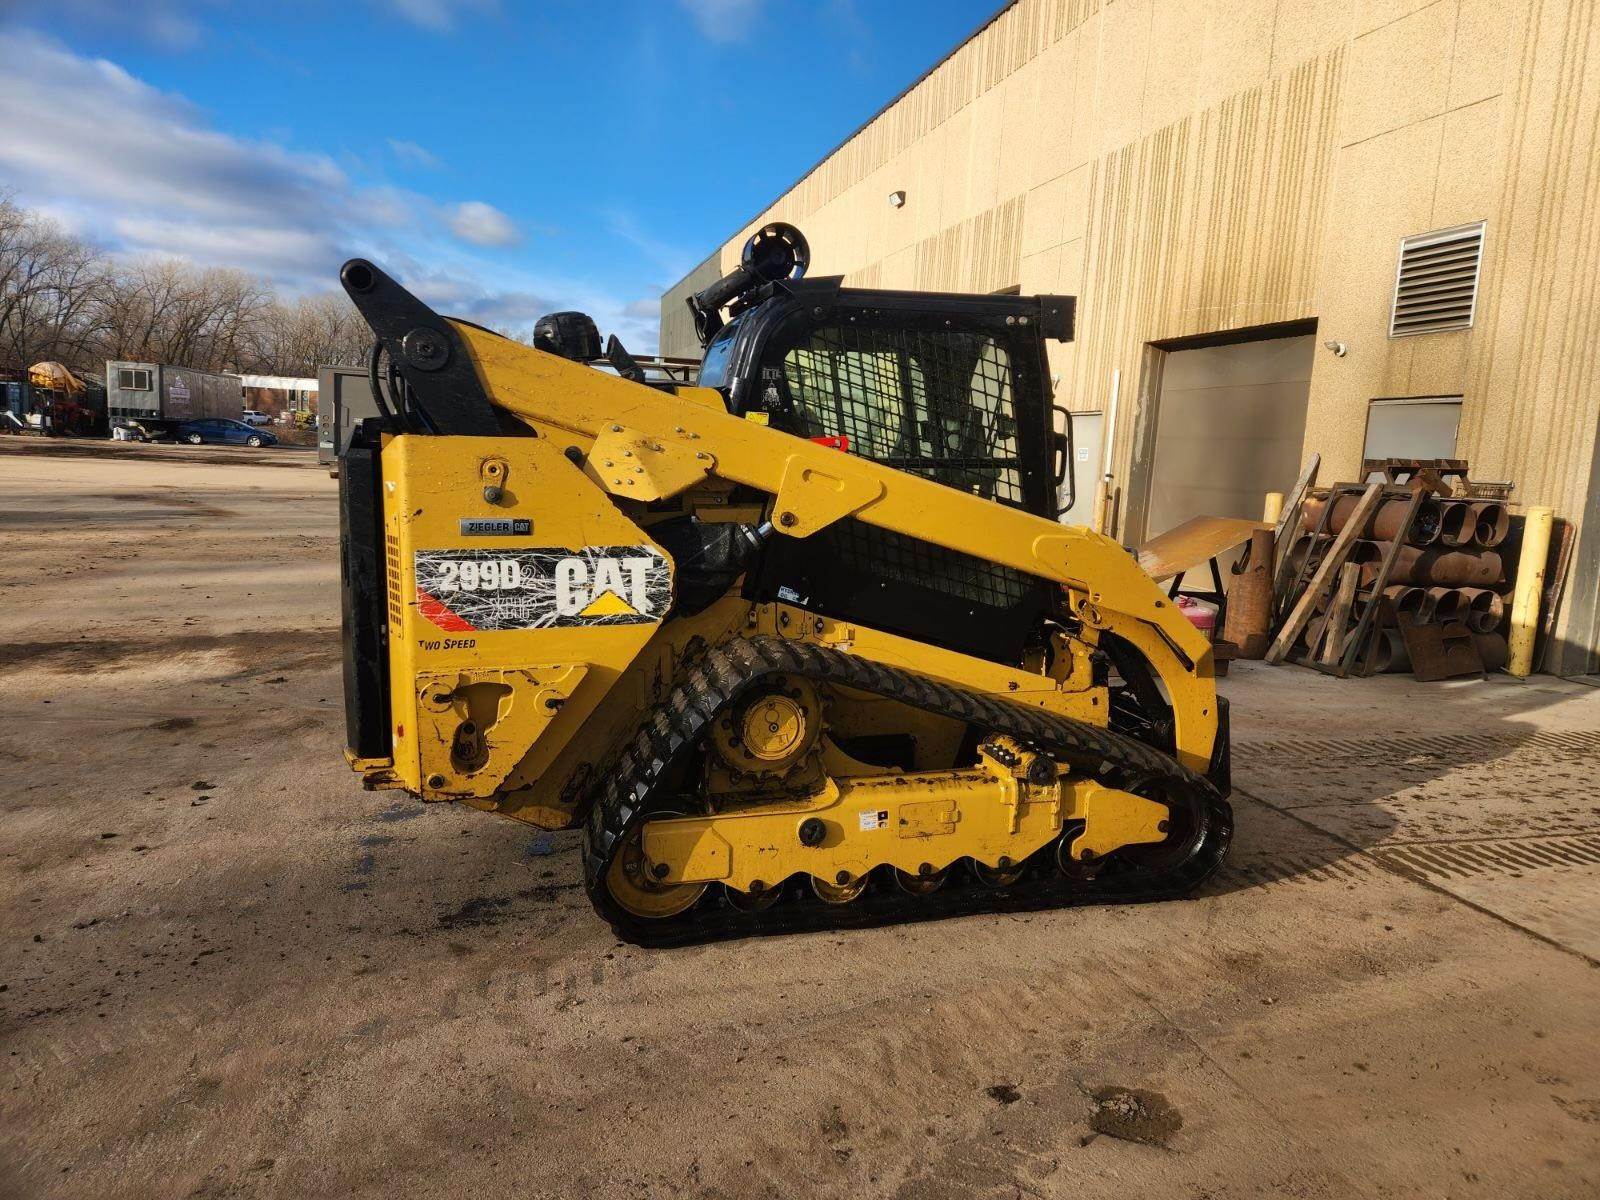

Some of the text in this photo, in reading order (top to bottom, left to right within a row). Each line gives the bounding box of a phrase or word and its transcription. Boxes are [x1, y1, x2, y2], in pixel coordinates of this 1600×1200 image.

[469, 522, 530, 532] ZIEGLER CAT
[555, 557, 654, 617] CAT
